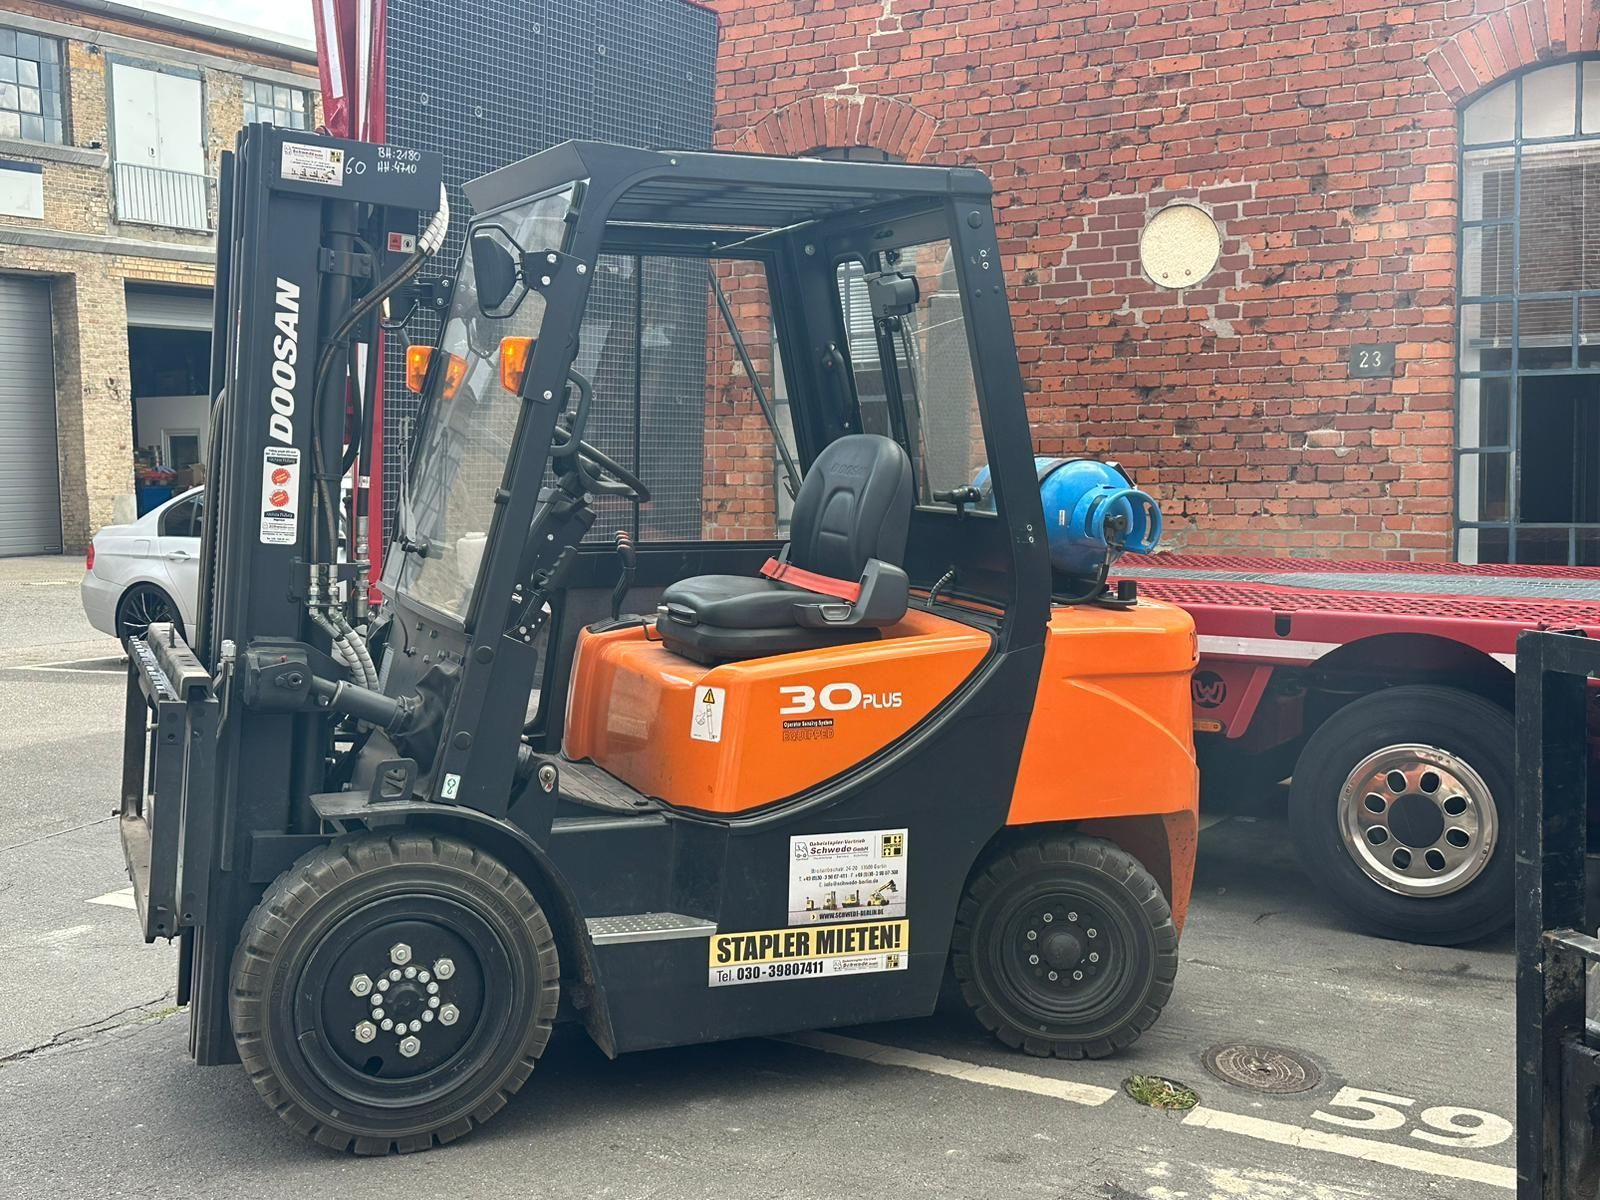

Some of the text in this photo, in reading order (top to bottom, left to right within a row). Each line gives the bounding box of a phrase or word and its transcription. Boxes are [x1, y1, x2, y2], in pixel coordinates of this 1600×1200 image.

[269, 276, 301, 446] DOOSAN
[1359, 350, 1382, 368] 23
[779, 682, 903, 715] 30 PLUS
[818, 719, 833, 727] System
[810, 845, 852, 855] Schwede
[716, 924, 902, 963] STAPLER MIETEN!
[716, 970, 735, 983] Tel.
[1309, 1085, 1514, 1149] 59
